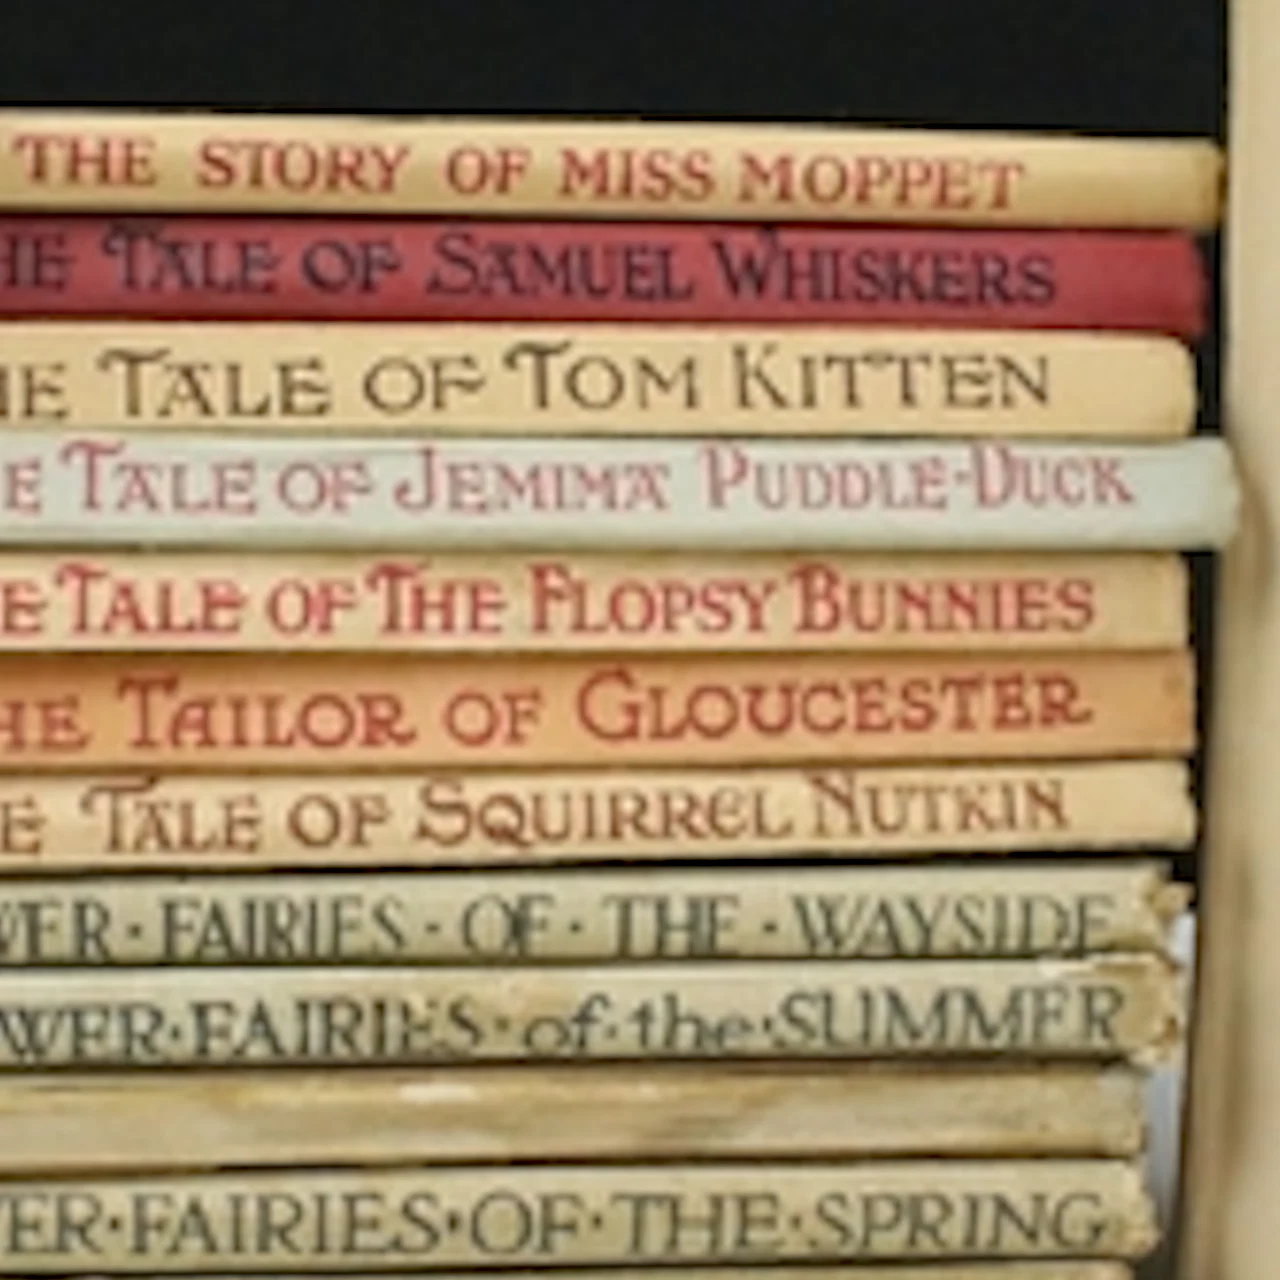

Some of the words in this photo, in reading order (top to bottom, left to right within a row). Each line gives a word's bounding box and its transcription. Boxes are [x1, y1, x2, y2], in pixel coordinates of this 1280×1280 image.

[15, 134, 157, 186] THE
[196, 140, 410, 193] STORY
[446, 147, 531, 196] OF
[561, 149, 715, 200] MISS
[740, 153, 1025, 209] MOPPET
[101, 221, 278, 293] TALE
[301, 238, 400, 293] OF
[426, 233, 694, 302] SAMUEL
[711, 227, 1057, 307] WHISKERS
[98, 348, 330, 419] TALE
[363, 355, 486, 414] OF
[503, 340, 701, 412] TOM
[732, 344, 1052, 412] KITTEN
[60, 440, 258, 514] TALE
[276, 461, 375, 513] OF
[393, 446, 672, 514] JEMIMA
[700, 443, 1136, 512] PUDDLE-DUCK
[55, 562, 245, 637] TALE
[266, 579, 358, 635] OF
[366, 562, 508, 636] THE
[527, 562, 780, 635] FLOPSY
[787, 561, 1096, 634] BUNNIES
[118, 670, 416, 749] TAILOR
[441, 688, 547, 747] OF
[576, 666, 1094, 743] GLOUCESTER
[81, 776, 261, 854] TALE
[287, 795, 393, 849] OF
[417, 778, 794, 848] SQUIRREL
[802, 770, 1072, 839] NUTKIN
